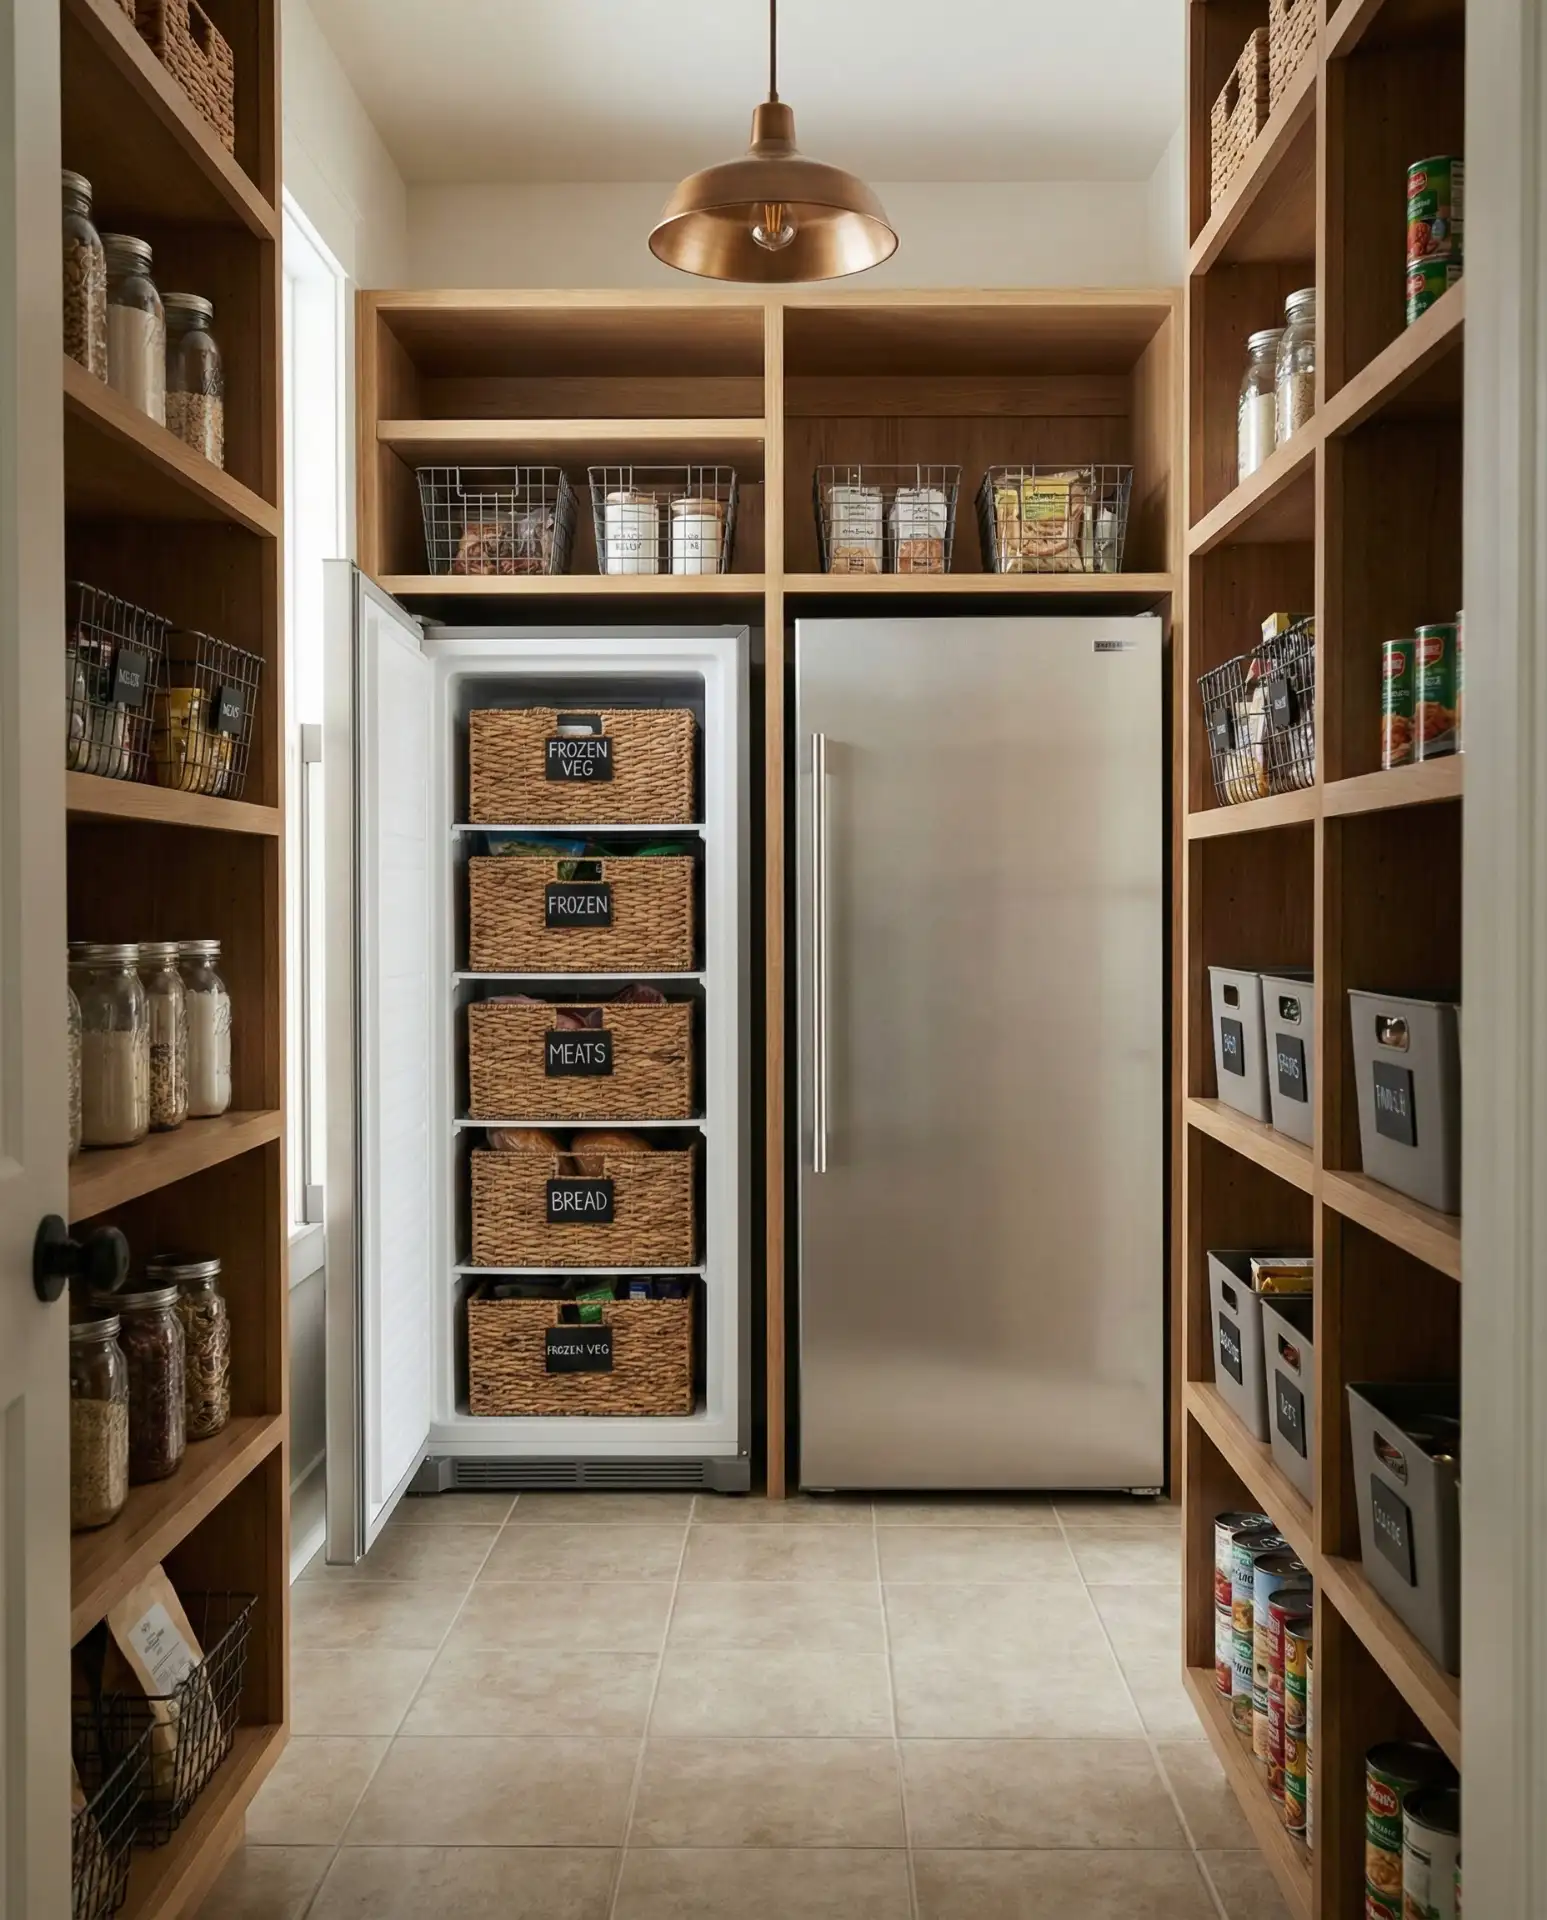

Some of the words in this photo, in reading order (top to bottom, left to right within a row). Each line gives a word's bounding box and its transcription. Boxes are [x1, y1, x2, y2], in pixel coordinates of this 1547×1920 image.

[548, 741, 607, 758] FROZEN
[562, 760, 594, 776] VEG
[548, 895, 609, 914] FROZEN
[549, 1043, 606, 1065] MEATS
[551, 1191, 607, 1211] BREAD
[547, 1344, 584, 1356] FROZEN
[587, 1344, 610, 1355] VEG
